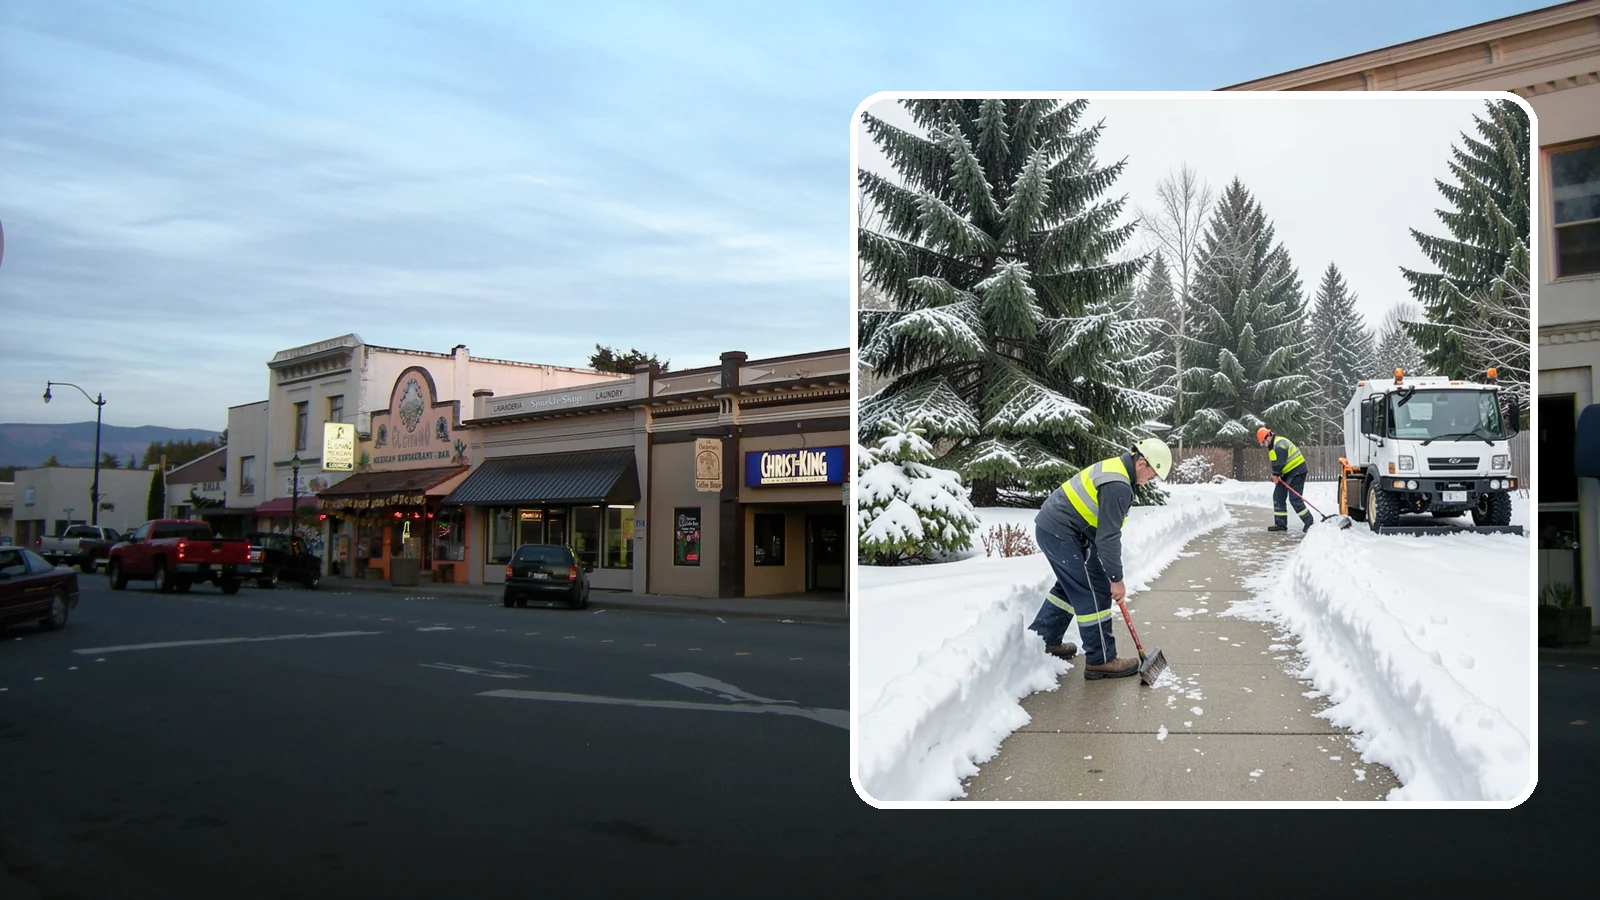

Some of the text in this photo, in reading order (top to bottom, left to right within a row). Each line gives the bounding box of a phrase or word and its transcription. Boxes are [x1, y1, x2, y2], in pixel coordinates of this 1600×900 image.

[595, 389, 623, 399] LAUNDRY
[493, 402, 522, 412] LAVANDERIA
[530, 395, 582, 409] Sparkle Shop
[373, 450, 450, 463] MEXICAN RESTAURANT BAR
[761, 450, 827, 478] CHRIST KING
[696, 481, 721, 489] Coffee House
